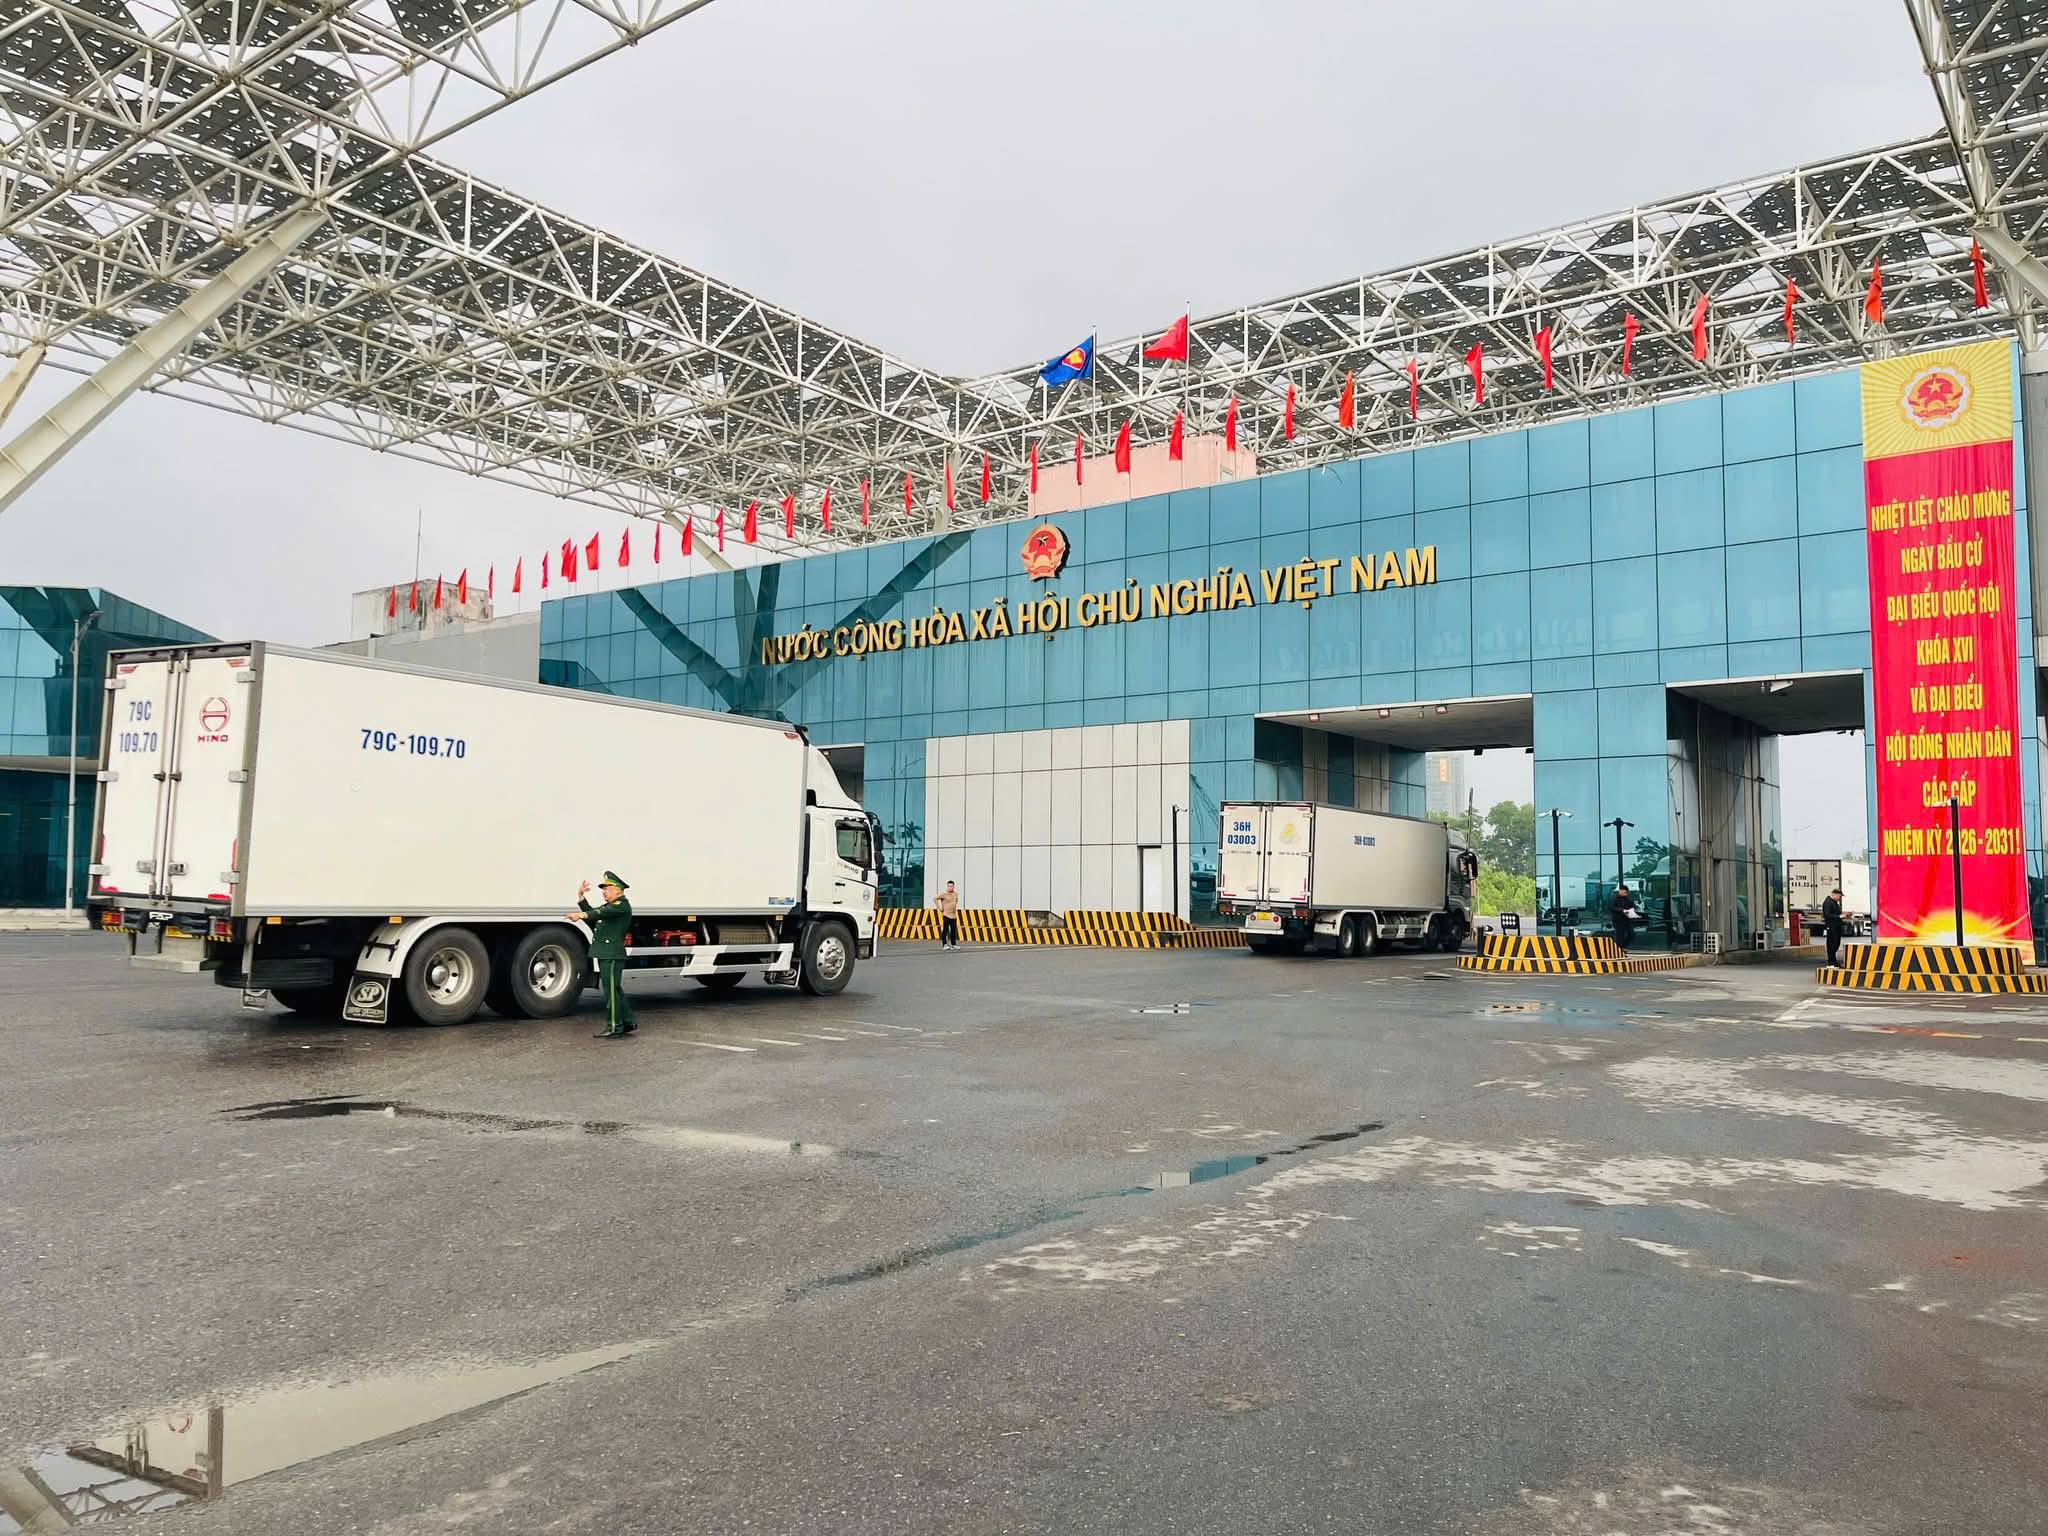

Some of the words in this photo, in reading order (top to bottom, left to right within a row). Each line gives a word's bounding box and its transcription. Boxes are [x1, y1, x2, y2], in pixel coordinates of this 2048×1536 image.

[1871, 499, 1905, 534] NHIỆT
[1908, 495, 1934, 531] LIỆT
[1937, 490, 1970, 523] CHÀO
[1973, 486, 2010, 519] MỪNG
[1901, 541, 1934, 574] NGÀY
[1937, 534, 1962, 569] BẦU
[1966, 531, 1983, 567] CỬ
[762, 624, 829, 665] NƯỚC
[833, 618, 905, 661] CỘNG
[911, 607, 969, 648] HÒA
[971, 596, 1011, 641] XÃ
[1018, 591, 1069, 641] HỘI
[1077, 577, 1142, 627] CHỦ
[1151, 566, 1254, 617] NGHĨA
[1260, 556, 1340, 609] VIỆT
[1351, 545, 1437, 593] NAM
[1887, 595, 1908, 626] ĐẠI
[1911, 582, 1939, 619] BIỂU
[1943, 580, 1976, 618] QUỐC
[1979, 580, 2000, 618] HỘI
[1917, 632, 1951, 666] KHÓA
[1953, 636, 1974, 663] XVI
[129, 701, 152, 722] 79C
[1910, 681, 1927, 713] VÀ
[1930, 685, 1951, 717] ĐẠI
[1954, 672, 1983, 711] BIỂU
[119, 732, 158, 752] 109.70
[197, 735, 229, 743] HINO
[361, 728, 465, 758] 79C-109.70
[1886, 730, 1906, 767] HỘI
[1909, 725, 1943, 760] ĐỒNG
[1946, 726, 1982, 759] NHÂN
[1985, 725, 2012, 757] DÂN
[1922, 776, 1948, 807] CÁC
[1227, 835, 1256, 845] 03003
[1233, 822, 1251, 832] 36H
[1884, 824, 1924, 862] NHIỆM
[1927, 824, 1942, 855] KỲ
